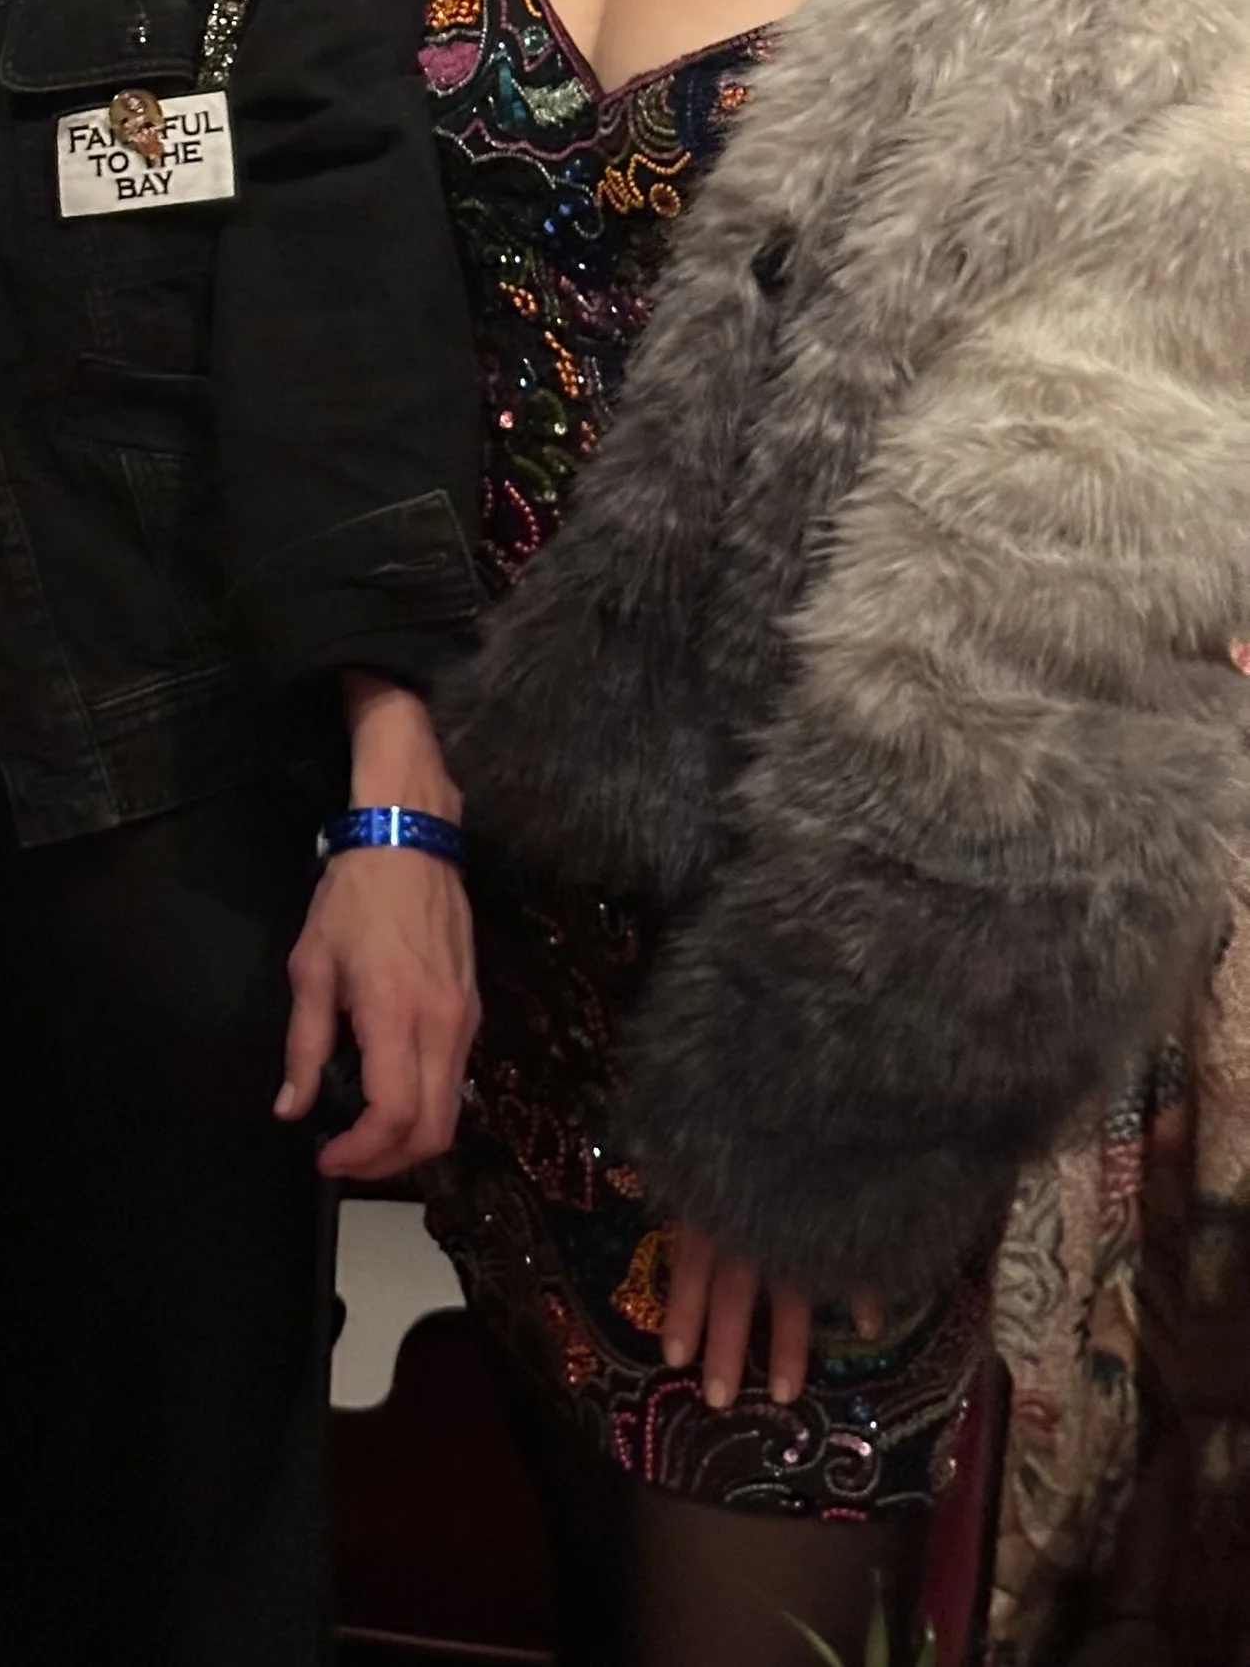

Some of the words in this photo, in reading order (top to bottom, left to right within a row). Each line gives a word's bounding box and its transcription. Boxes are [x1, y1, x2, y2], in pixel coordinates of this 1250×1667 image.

[67, 111, 224, 153] FAIFUL
[87, 150, 129, 176] TO
[146, 141, 203, 168] HE
[116, 170, 173, 200] BAY
